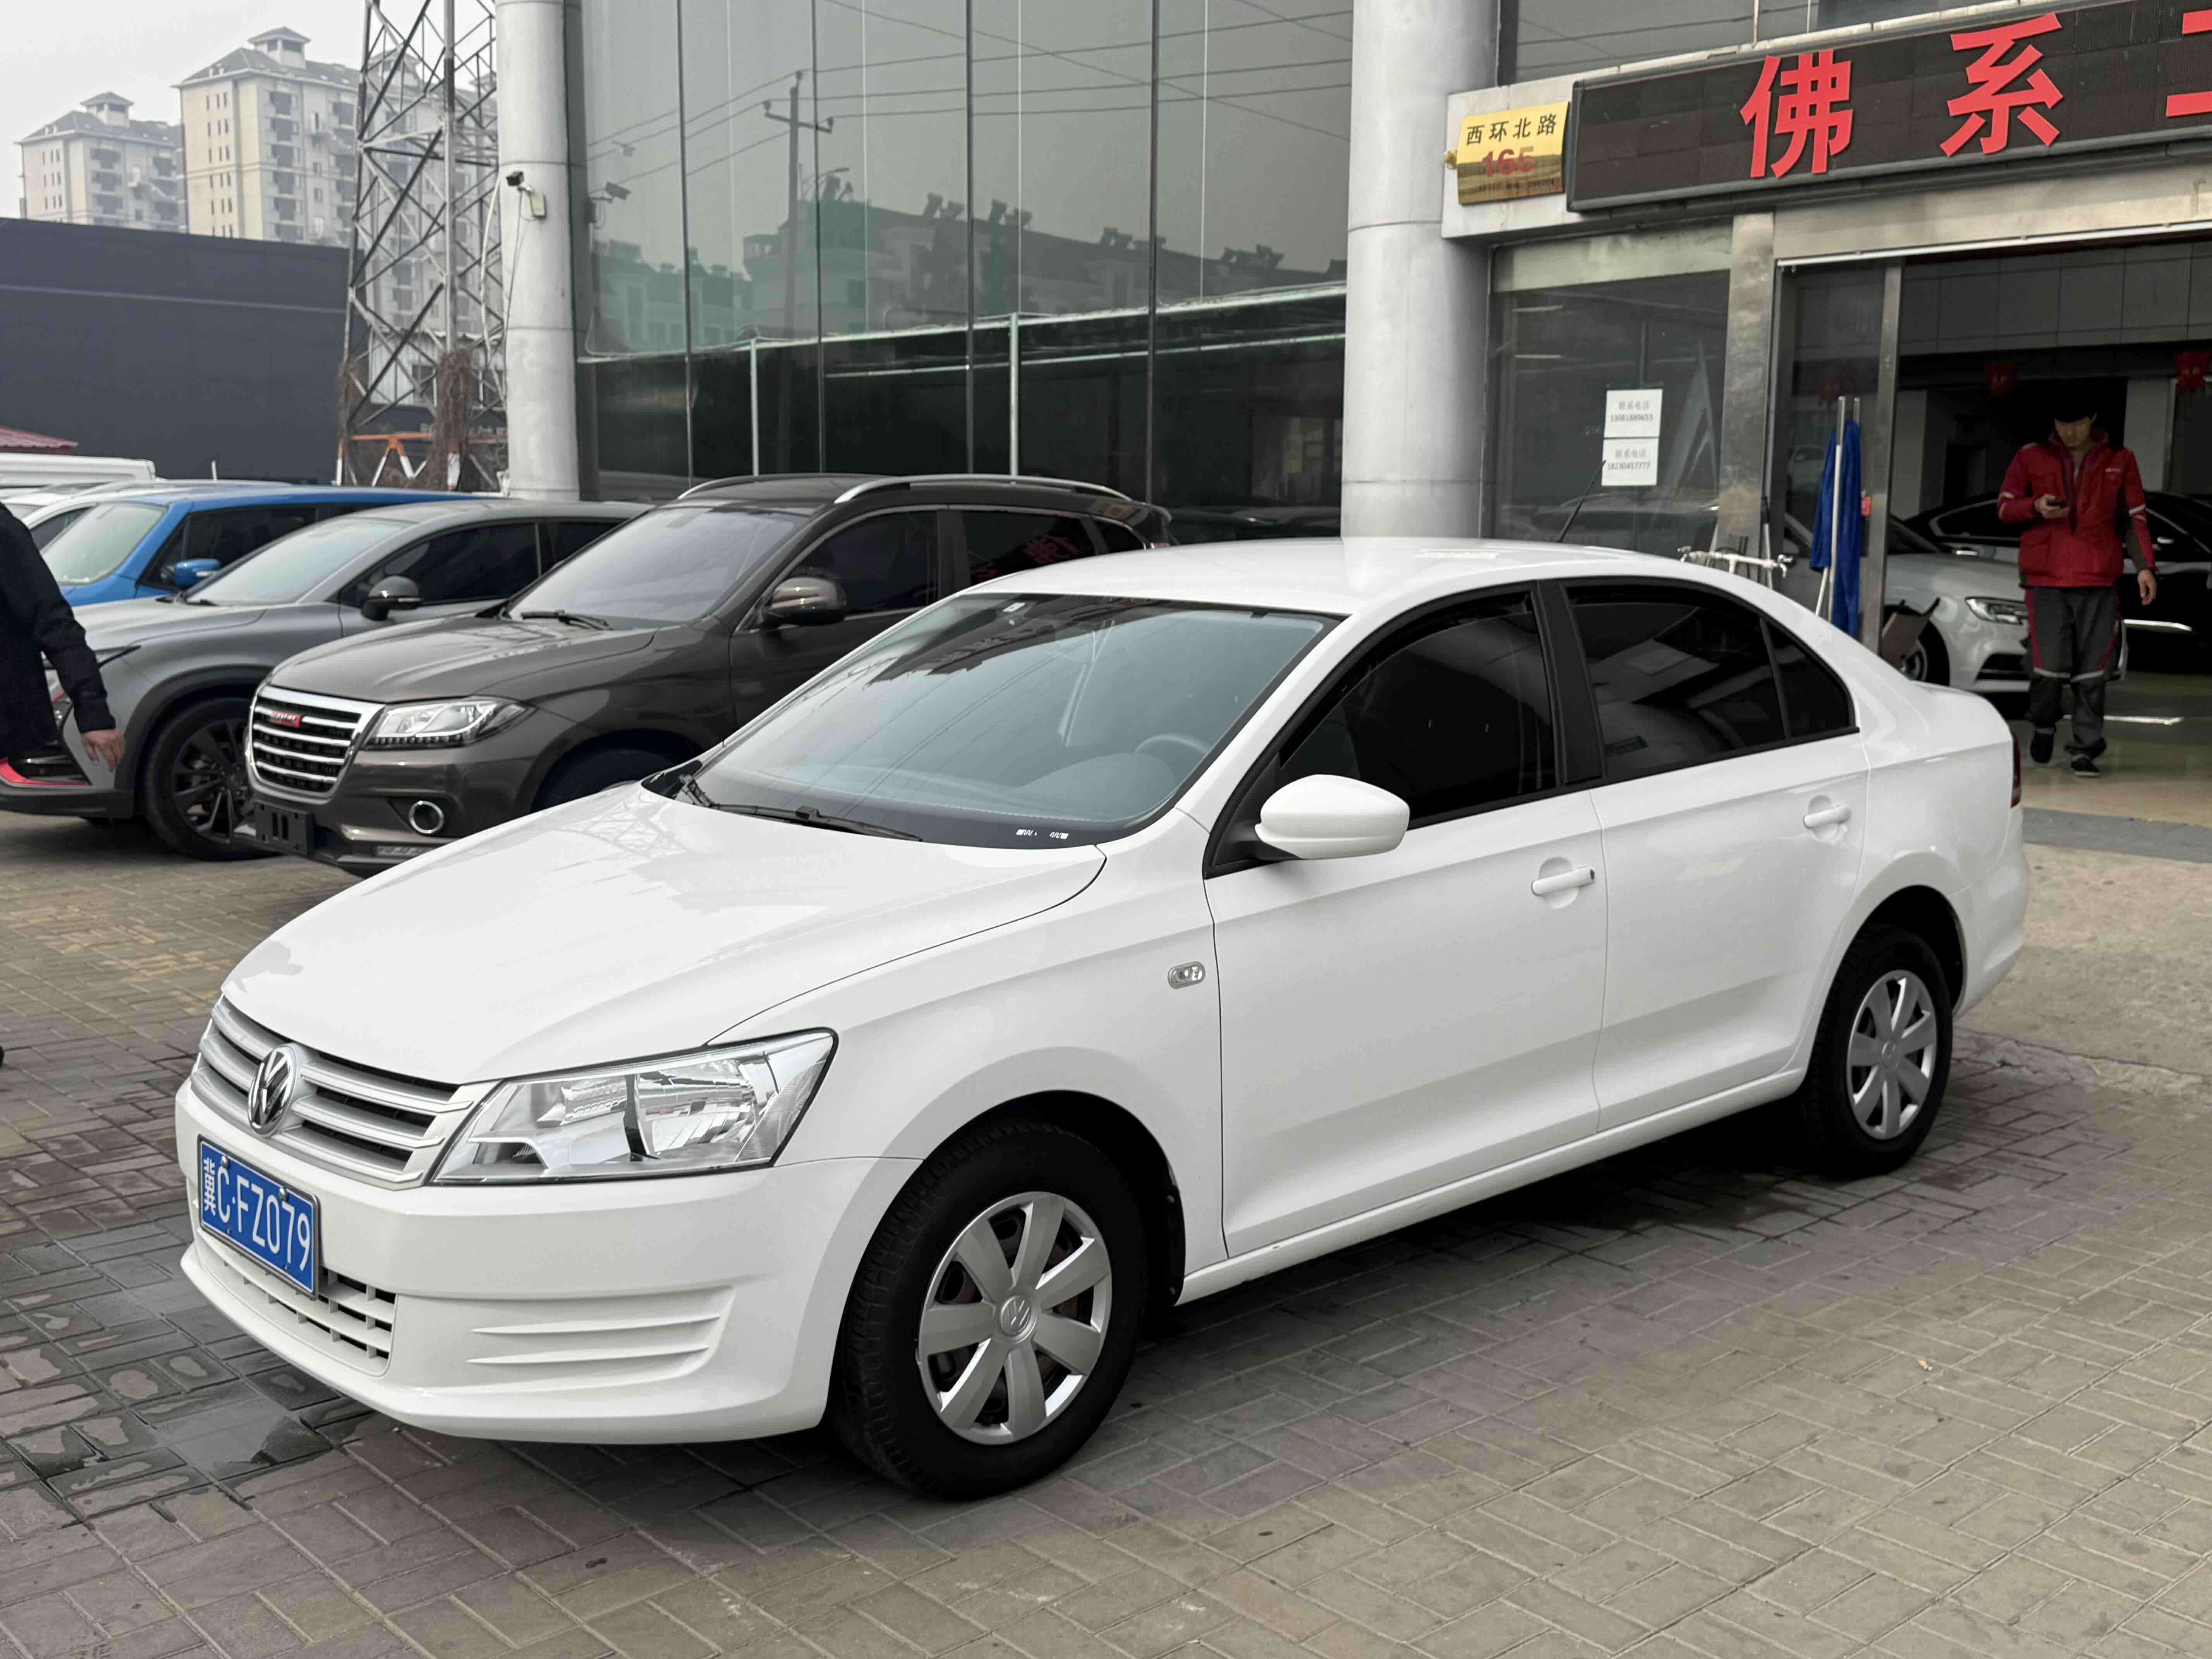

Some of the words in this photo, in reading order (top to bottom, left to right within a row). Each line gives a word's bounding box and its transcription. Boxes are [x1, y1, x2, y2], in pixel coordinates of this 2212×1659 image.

[1467, 113, 1556, 146] 西环北路
[1482, 146, 1534, 177] 165
